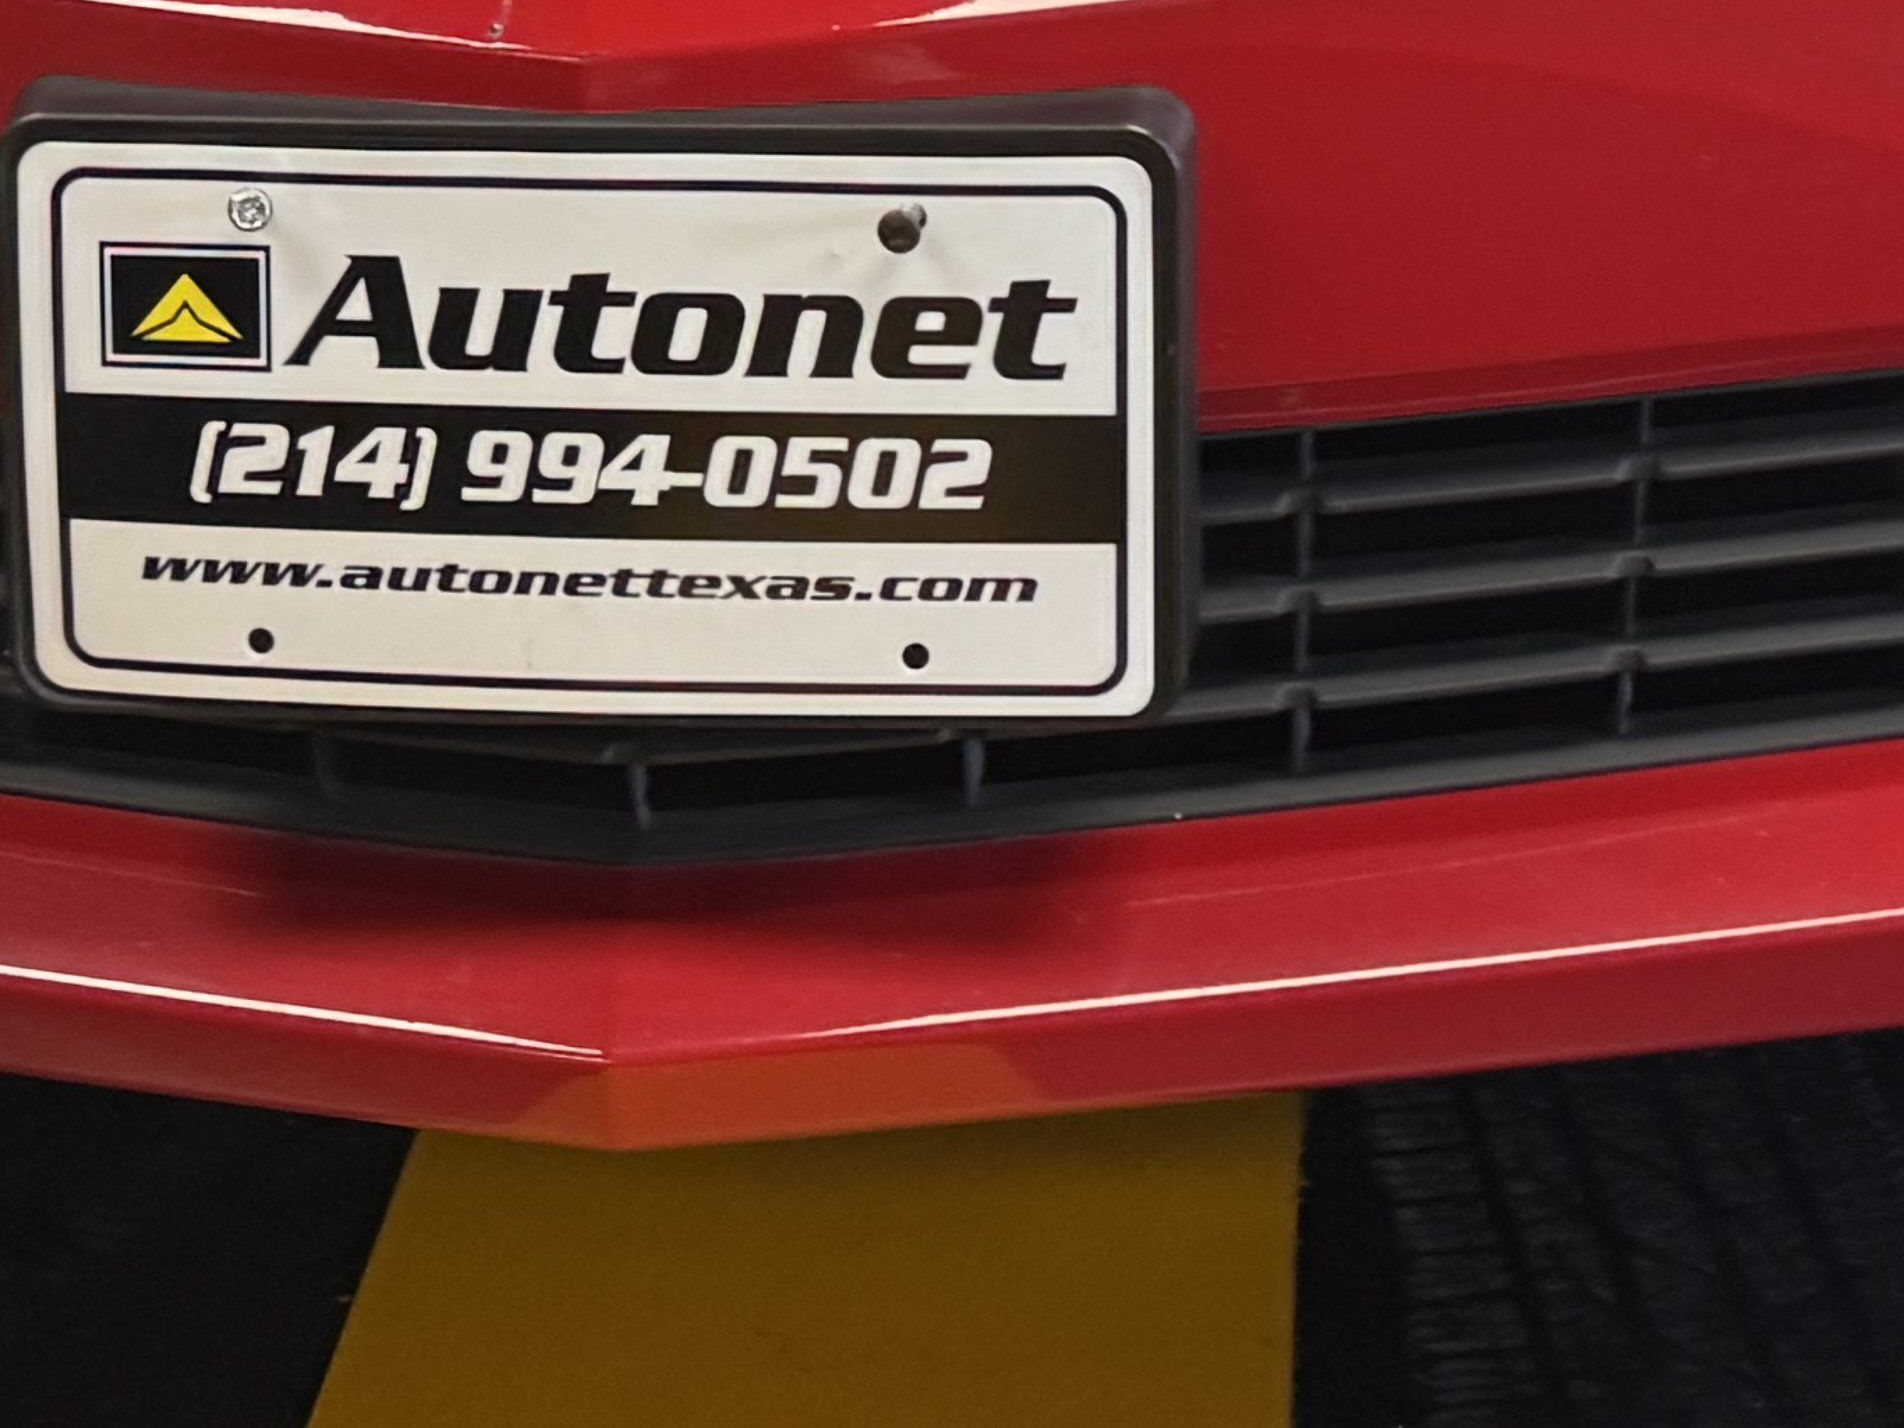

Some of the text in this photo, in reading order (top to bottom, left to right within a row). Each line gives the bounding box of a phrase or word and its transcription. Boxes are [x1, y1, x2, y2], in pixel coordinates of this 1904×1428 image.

[283, 254, 1079, 382] Autonet
[189, 419, 994, 512] (214) 994-0502
[140, 553, 1040, 605] www.autonettexas.com
